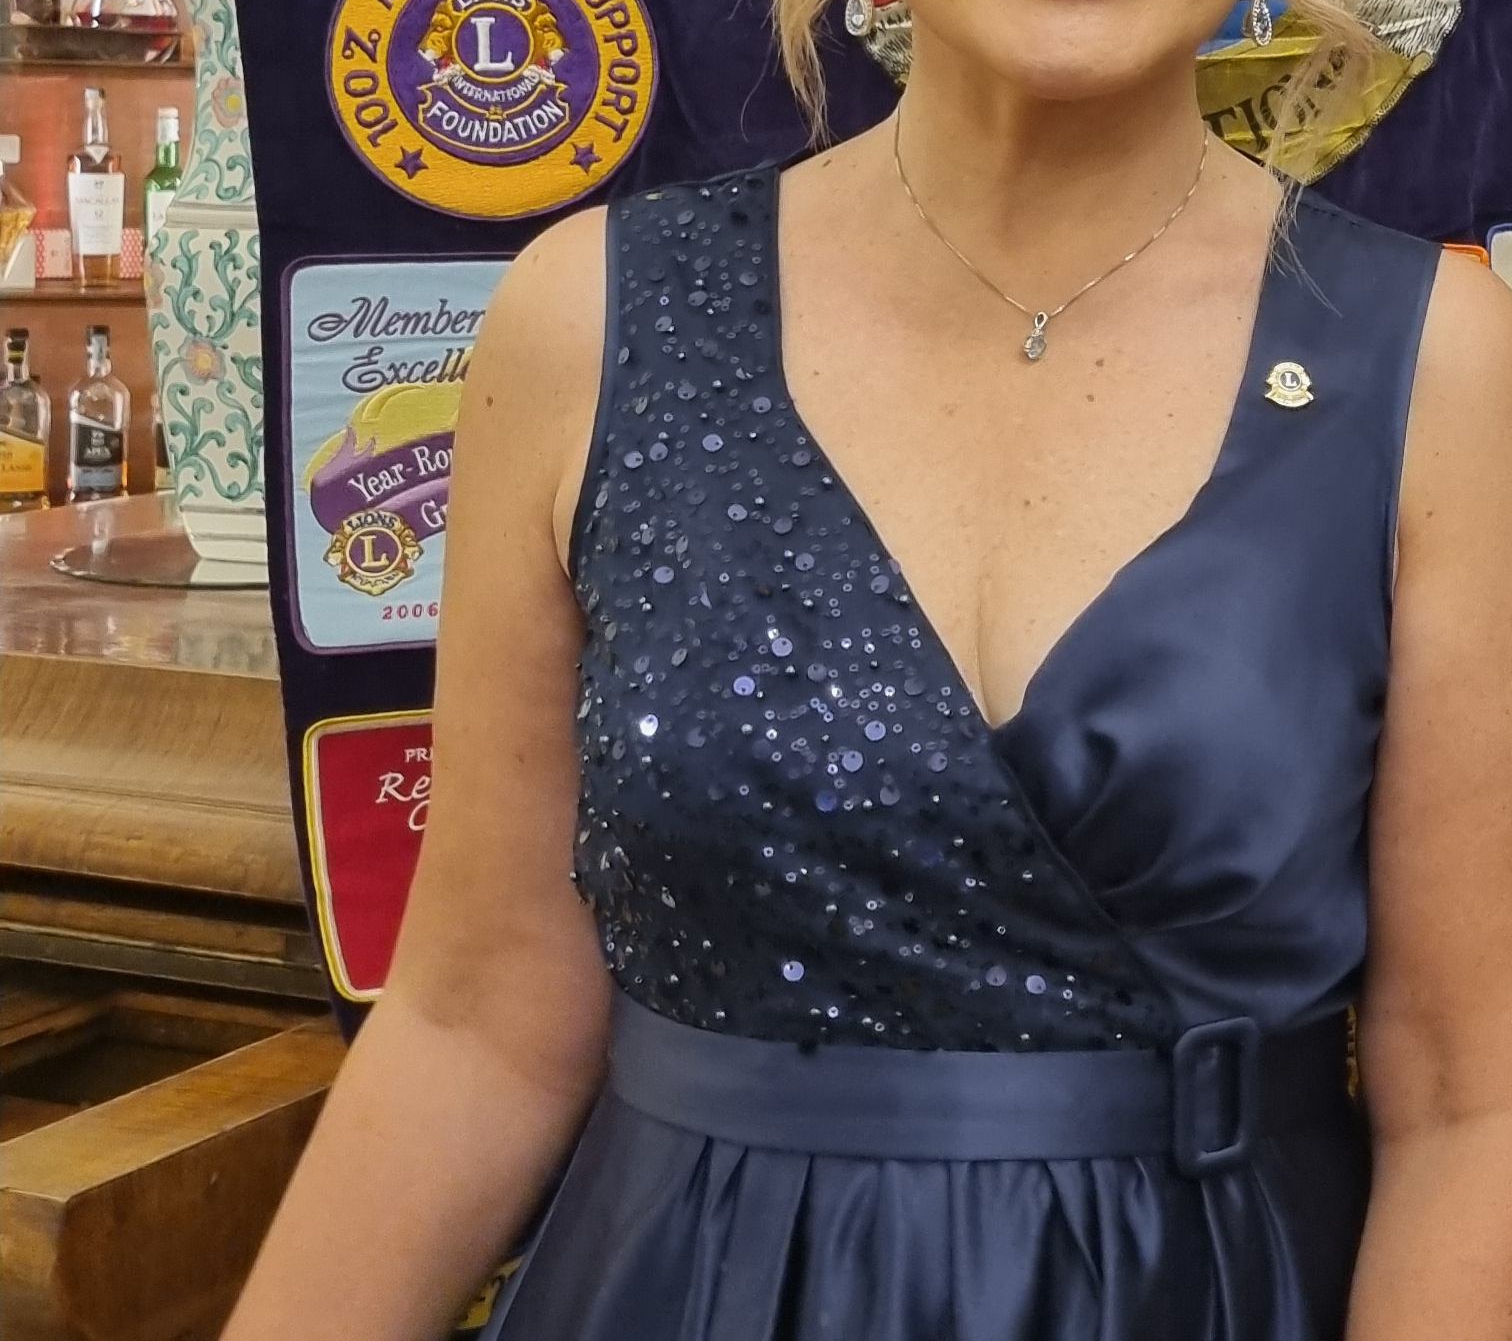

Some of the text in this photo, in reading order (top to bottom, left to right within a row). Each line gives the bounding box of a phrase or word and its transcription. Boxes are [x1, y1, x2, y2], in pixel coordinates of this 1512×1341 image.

[470, 16, 516, 73] L
[452, 73, 542, 104] INTERNATIONAL
[427, 99, 565, 144] FOUNDATION
[306, 296, 486, 342] Member
[341, 345, 471, 394] Excell
[348, 445, 454, 504] Year-Ro
